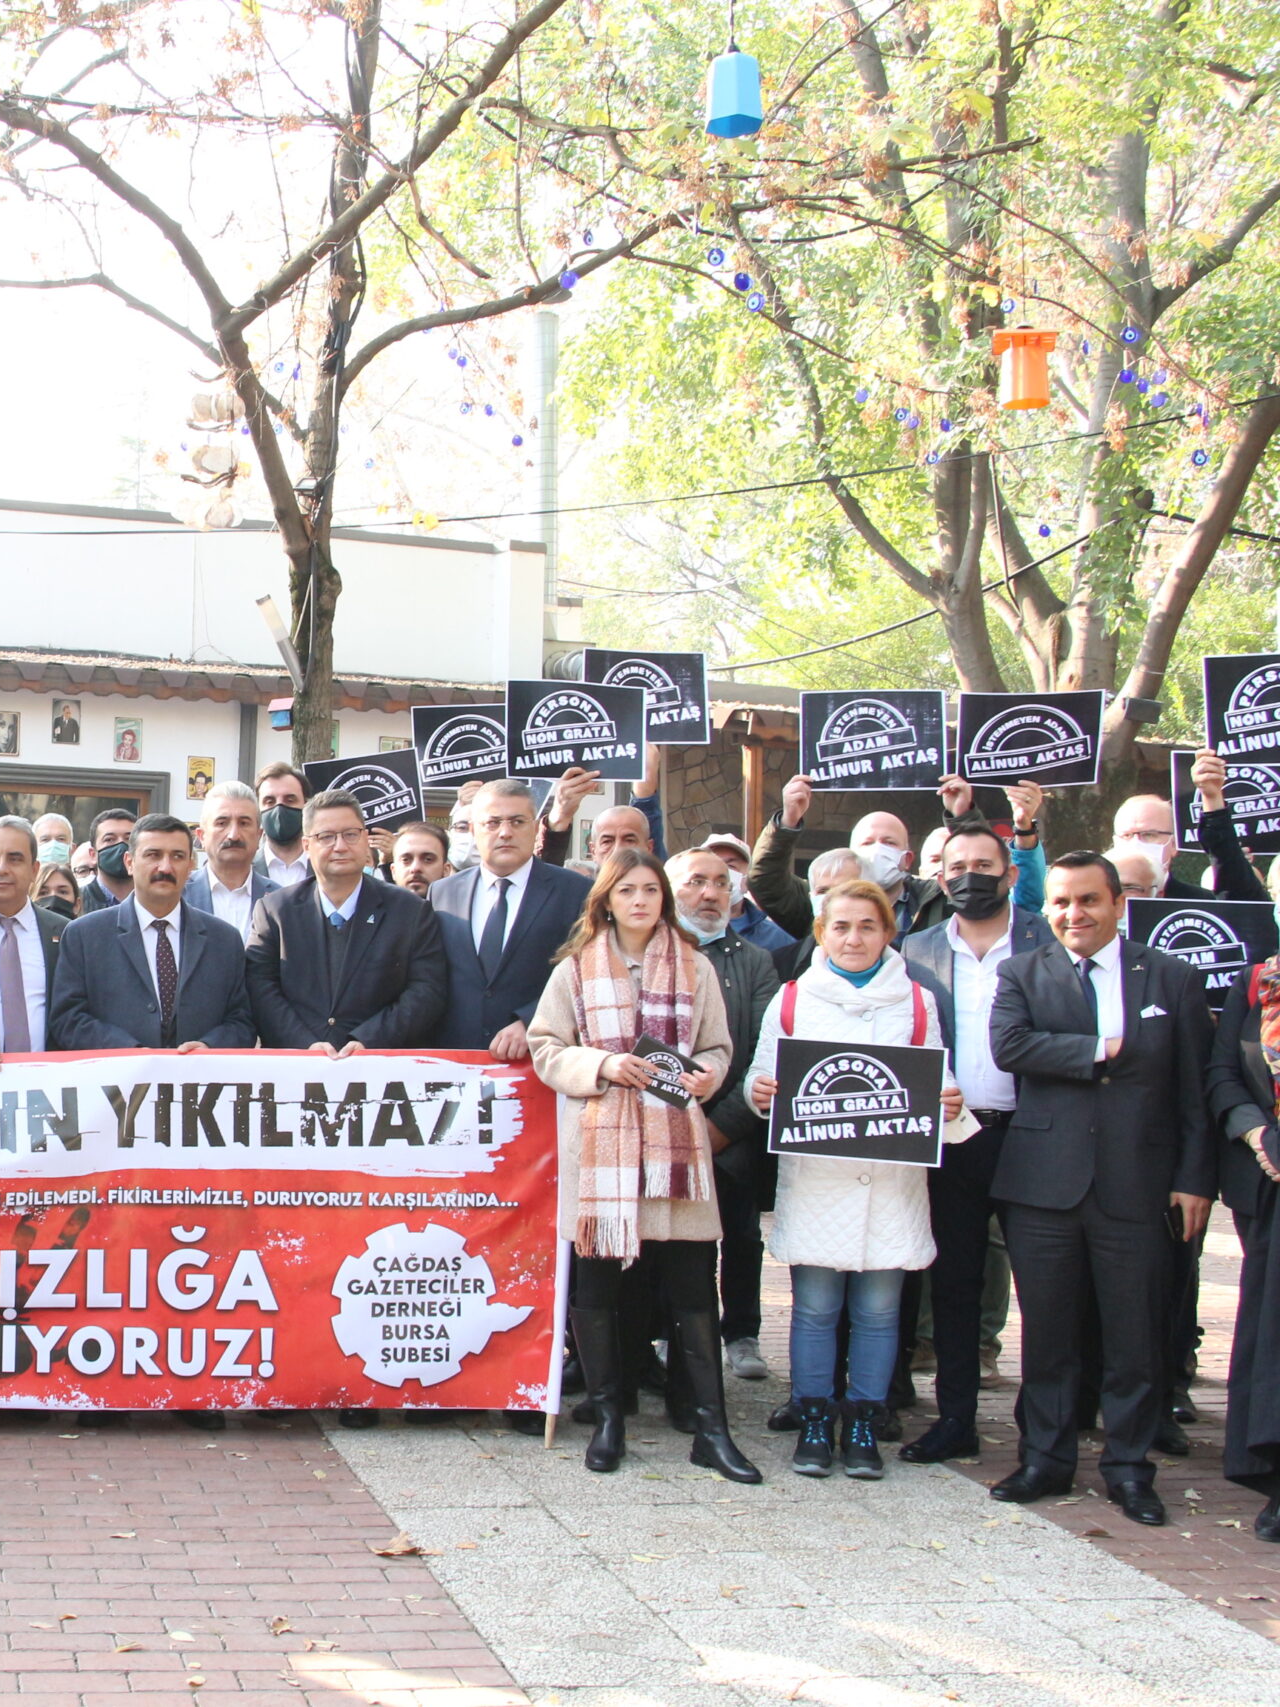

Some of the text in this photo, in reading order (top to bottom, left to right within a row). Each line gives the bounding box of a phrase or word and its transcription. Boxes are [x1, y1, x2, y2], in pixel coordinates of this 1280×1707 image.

[610, 666, 664, 688] TENMEYEN
[535, 695, 599, 727] PERSONA
[649, 705, 701, 726] AKTAŞ
[829, 706, 897, 739] İSTENMEYEN
[1229, 711, 1268, 729] NON
[432, 724, 502, 757] İSTENMEYEN ADAM
[526, 726, 611, 745] NON GRATA
[842, 735, 890, 753] ADAM
[982, 715, 1069, 751] İSTENMEYEN ADAM
[426, 751, 506, 776] ALİNUR AKTA
[515, 742, 637, 770] ALİNUR AKTAŞ
[809, 747, 938, 781] ALİNUR AKTAŞ
[971, 743, 1084, 772] ALİNUR AKTAŞ
[374, 775, 396, 794] ADAM
[1226, 767, 1275, 792] SONA
[373, 795, 411, 816] AKTAŞ
[1233, 797, 1280, 814] GRAT
[809, 1058, 889, 1095] PERSONA
[660, 1083, 690, 1100] AKTAŞ
[101, 1081, 494, 1150] YIKILMAZ!
[797, 1094, 903, 1116] NON GRATA
[780, 1115, 933, 1144] ALİNUR AKTAŞ
[5, 1186, 102, 1206] EDİLEMEDİ.
[107, 1186, 248, 1208] FİKİRLERİMİZLE,
[253, 1191, 363, 1207] DURUYORUZ
[367, 1191, 519, 1211] KARŞILARINDA...
[373, 1253, 462, 1277] ÇAĞDAŞ
[347, 1275, 486, 1295] GAZETECİLER
[371, 1297, 462, 1318] DERNEĞİ
[382, 1324, 450, 1340] BURSA
[380, 1343, 450, 1368] ŞUBESİ
